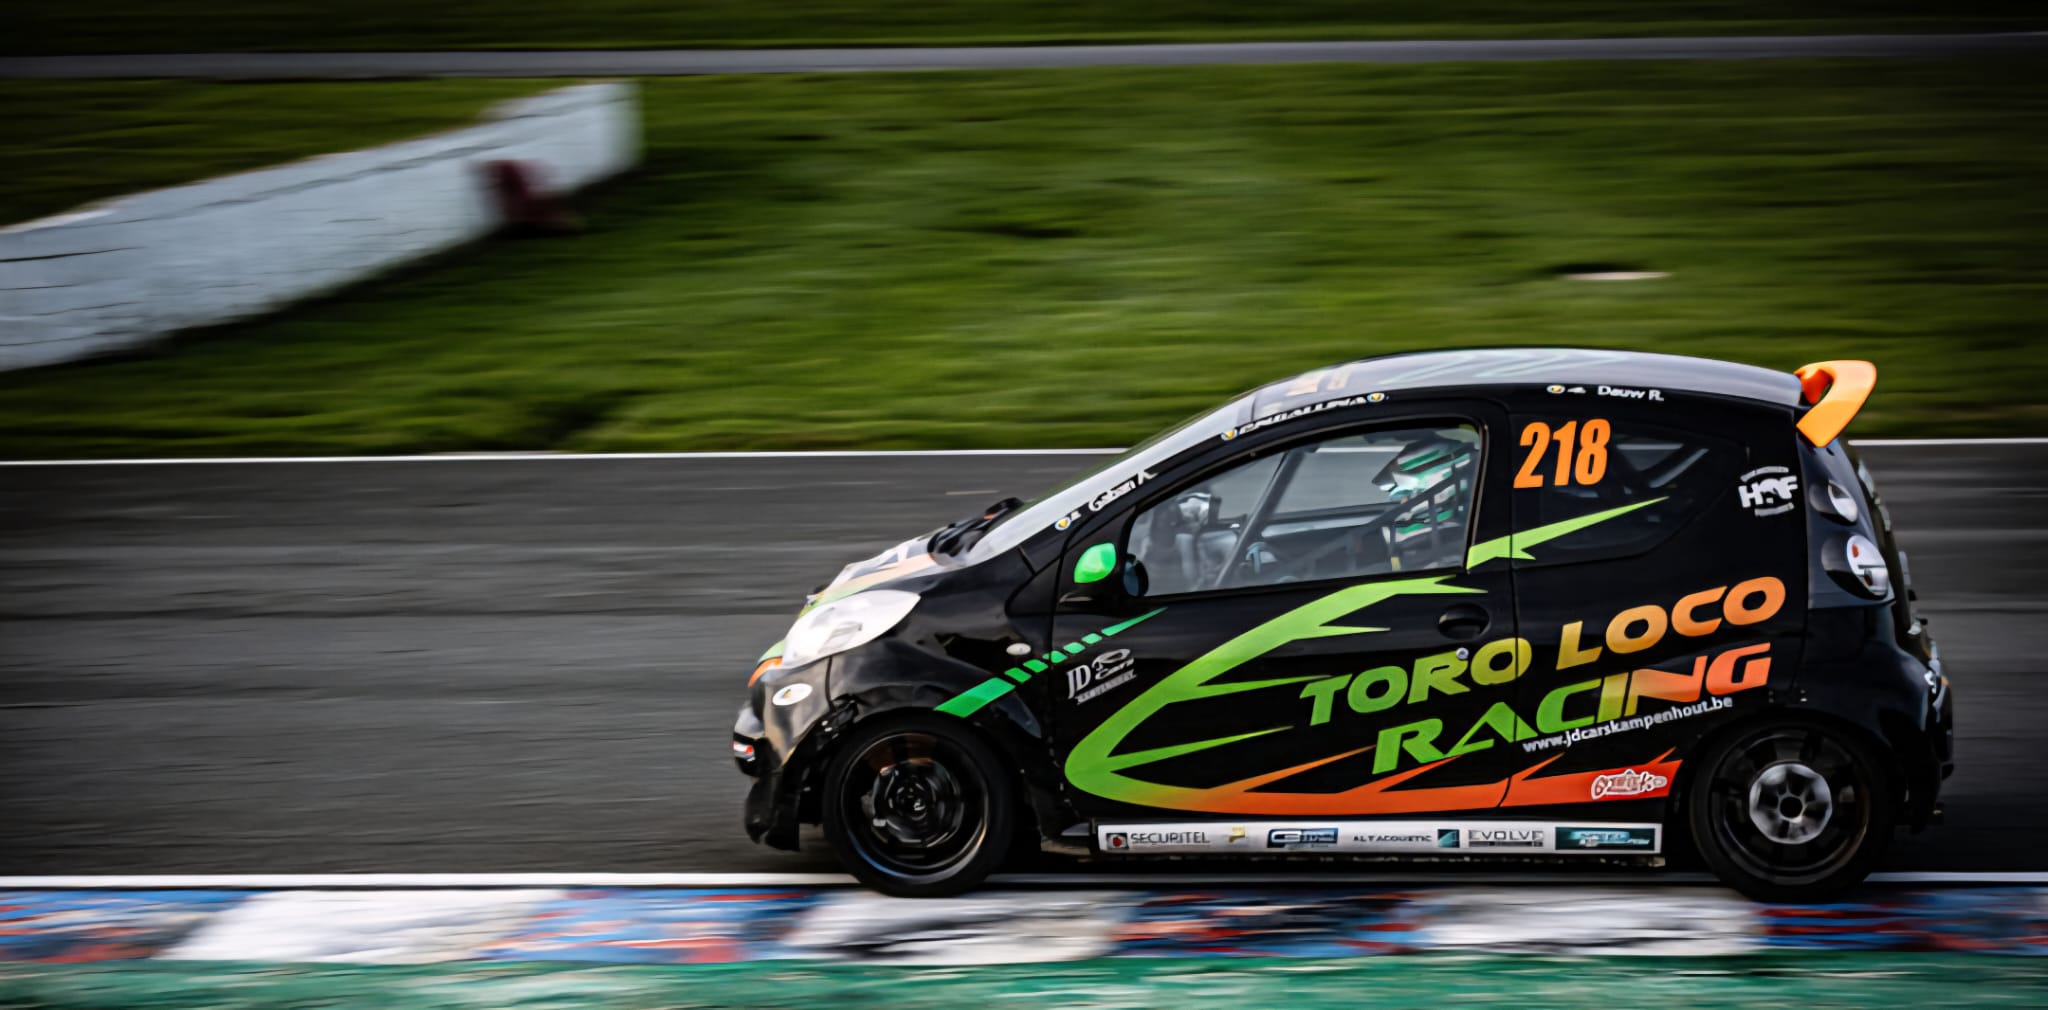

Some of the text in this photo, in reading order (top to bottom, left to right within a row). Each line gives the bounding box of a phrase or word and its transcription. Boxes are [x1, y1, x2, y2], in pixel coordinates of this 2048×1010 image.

[1513, 418, 1612, 489] 218
[1299, 576, 1786, 726] TORO LOCO
[1066, 664, 1091, 700] JD
[1371, 642, 1772, 775] RACING
[1521, 696, 1734, 753] www.jdcarskampenhout.be
[1130, 831, 1211, 844] SECURITEL
[1467, 829, 1545, 841] EVOLVE
